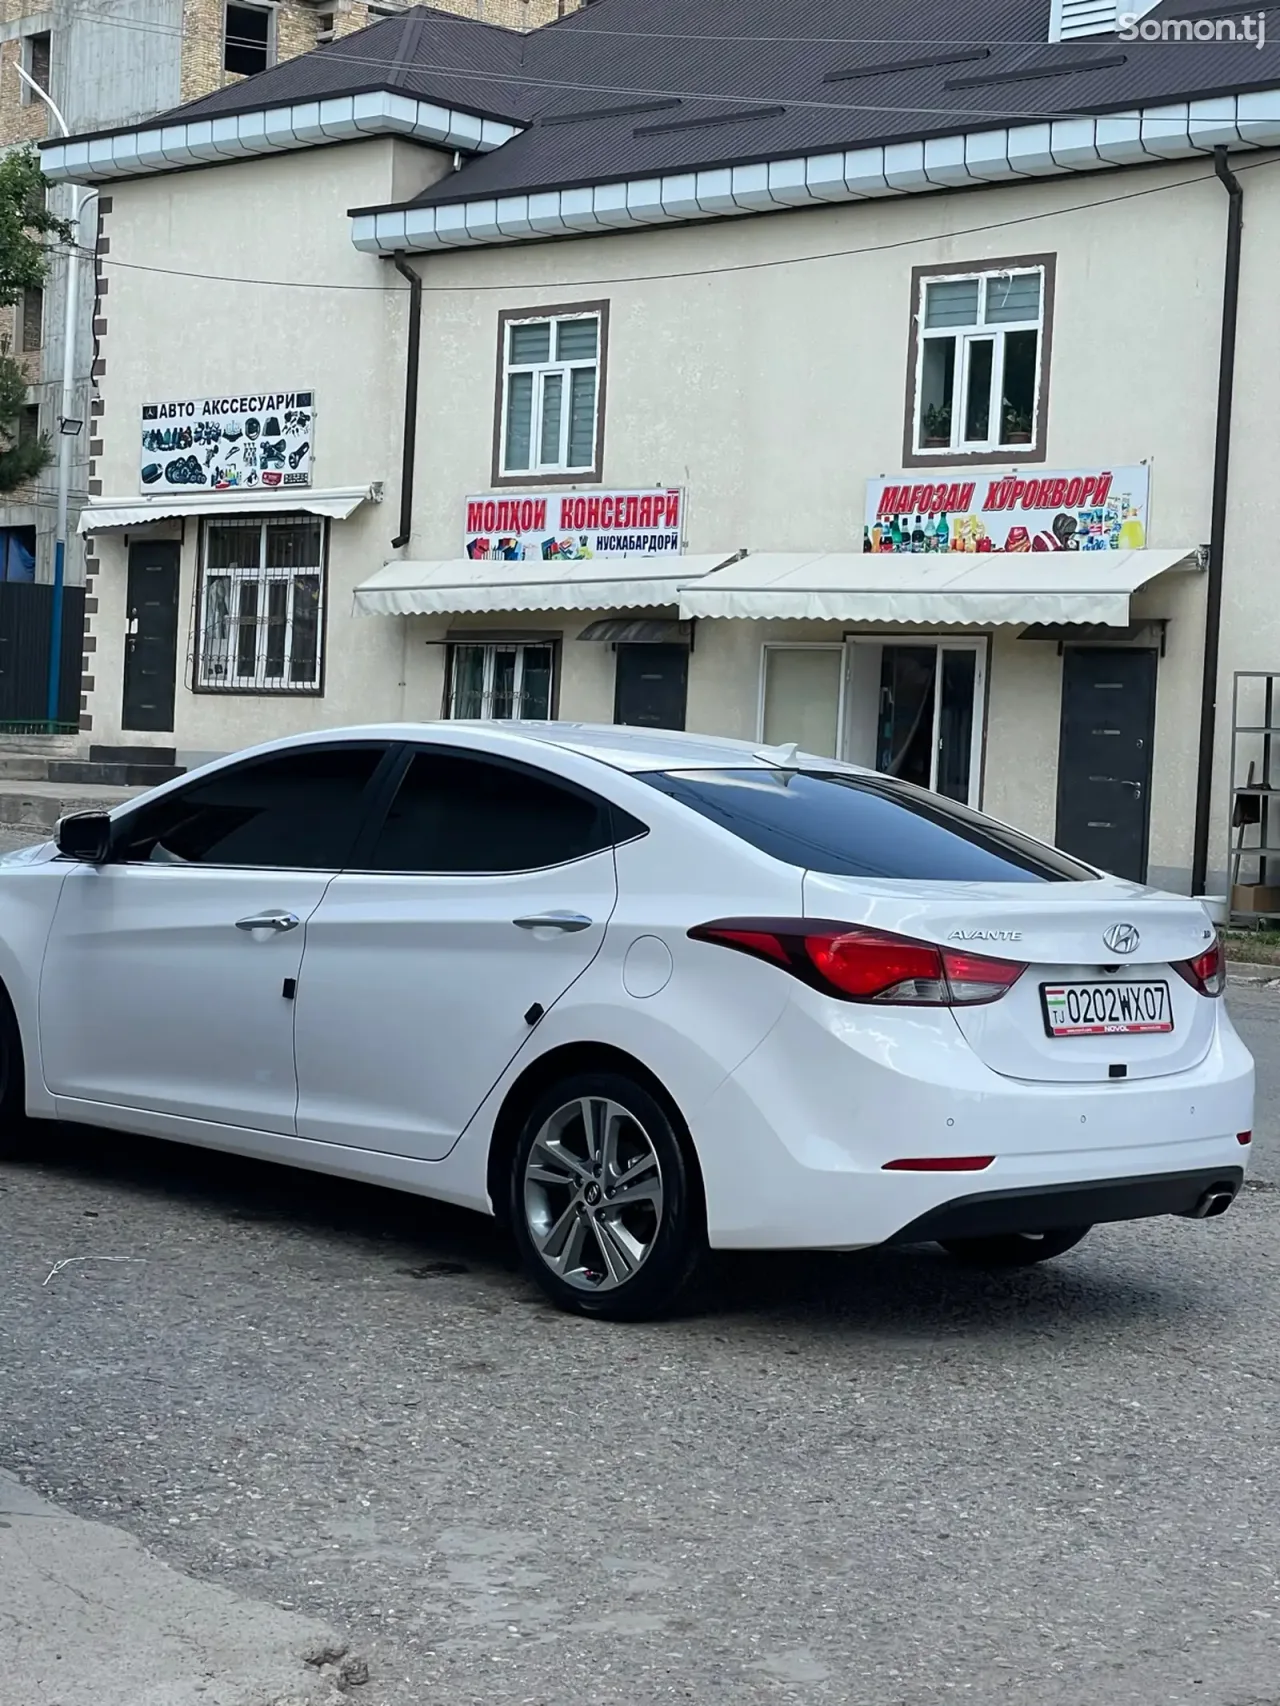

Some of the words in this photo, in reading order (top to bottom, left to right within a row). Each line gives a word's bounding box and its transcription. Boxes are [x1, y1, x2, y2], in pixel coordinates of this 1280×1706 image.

[158, 402, 195, 419] АВТО
[202, 393, 296, 416] АКССЕСУАРИ
[948, 929, 1024, 941] AVANTE
[1067, 987, 1165, 1023] 0202WX07
[1053, 1010, 1065, 1025] TJ
